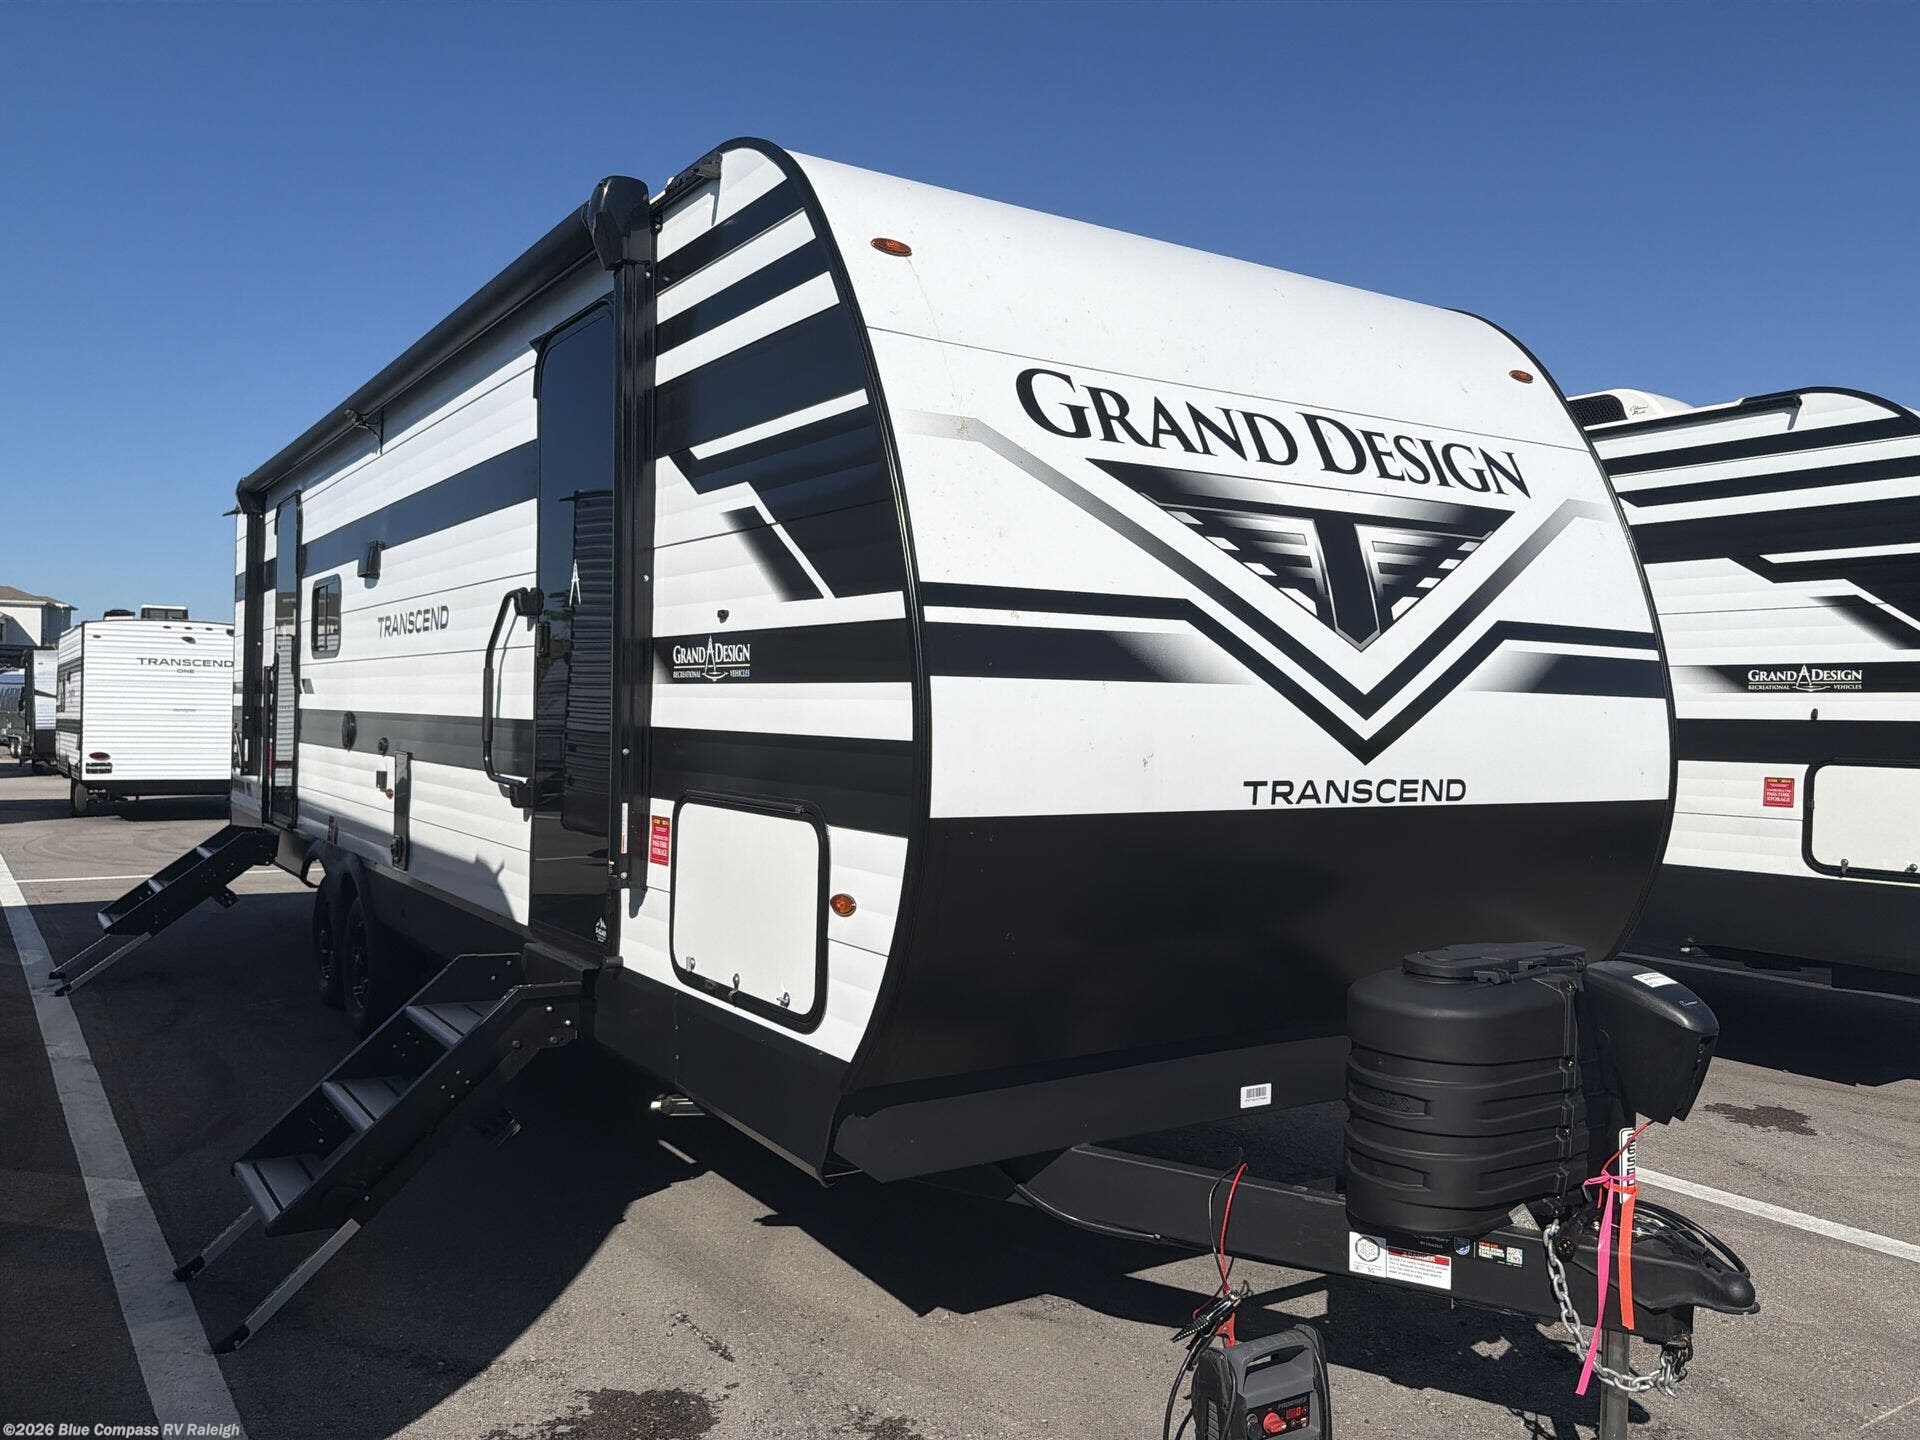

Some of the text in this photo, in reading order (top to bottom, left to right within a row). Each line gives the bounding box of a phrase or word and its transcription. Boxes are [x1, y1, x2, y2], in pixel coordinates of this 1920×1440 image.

[1015, 367, 1532, 499] GRAND DESIGN
[377, 605, 450, 639] TRANSCEND
[136, 657, 234, 668] TRANSCEND
[673, 644, 751, 664] GRAND DESIGN
[729, 669, 751, 678] VEHICLES
[1747, 669, 1863, 681] GRAND DESIGN
[1243, 778, 1467, 806] TRANSCEND
